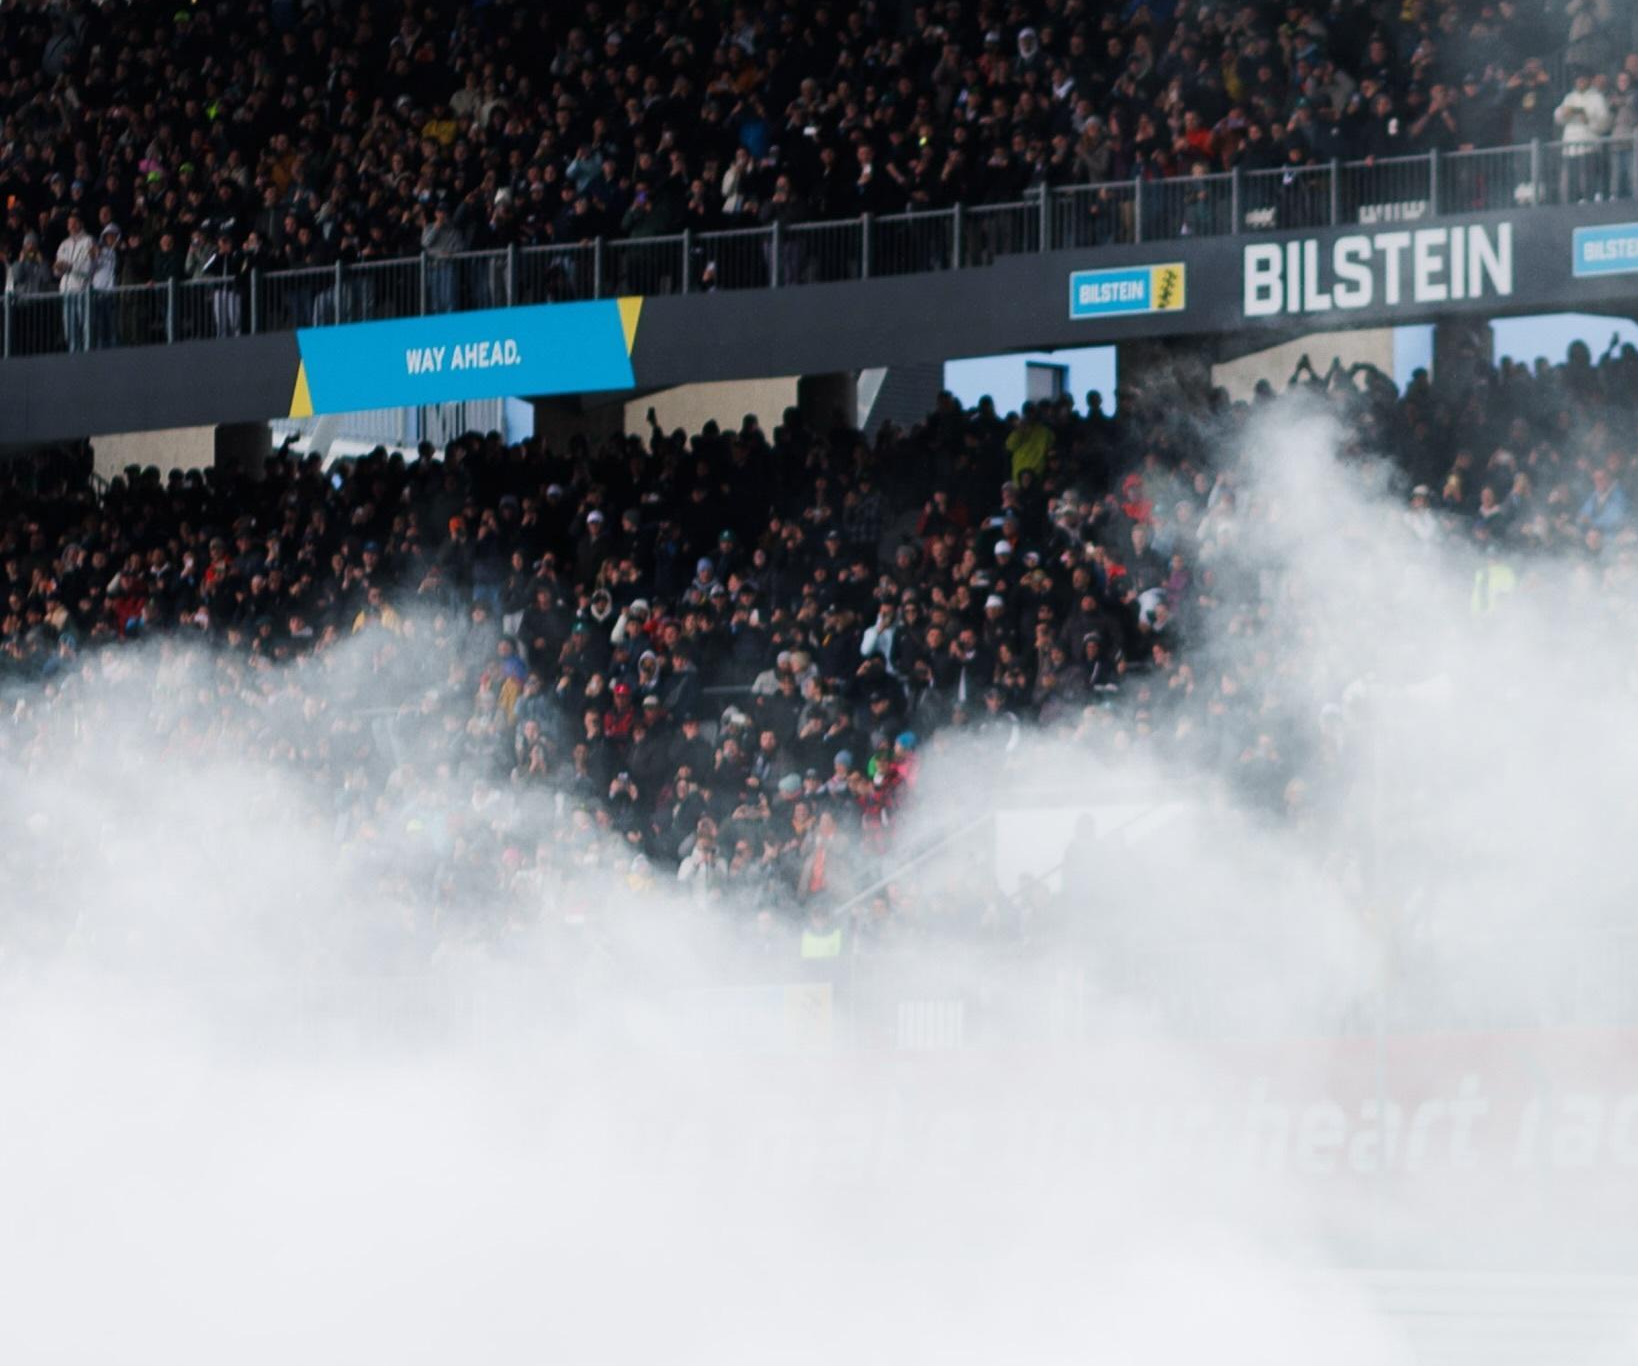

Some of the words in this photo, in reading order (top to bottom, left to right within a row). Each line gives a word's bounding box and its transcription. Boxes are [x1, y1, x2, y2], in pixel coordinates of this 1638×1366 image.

[1079, 278, 1145, 305] BILSTEIN
[1243, 222, 1513, 317] BILSTEIN
[406, 344, 444, 375] WAY
[450, 339, 522, 370] AHEAD.
[1246, 1073, 1490, 1173] heart
